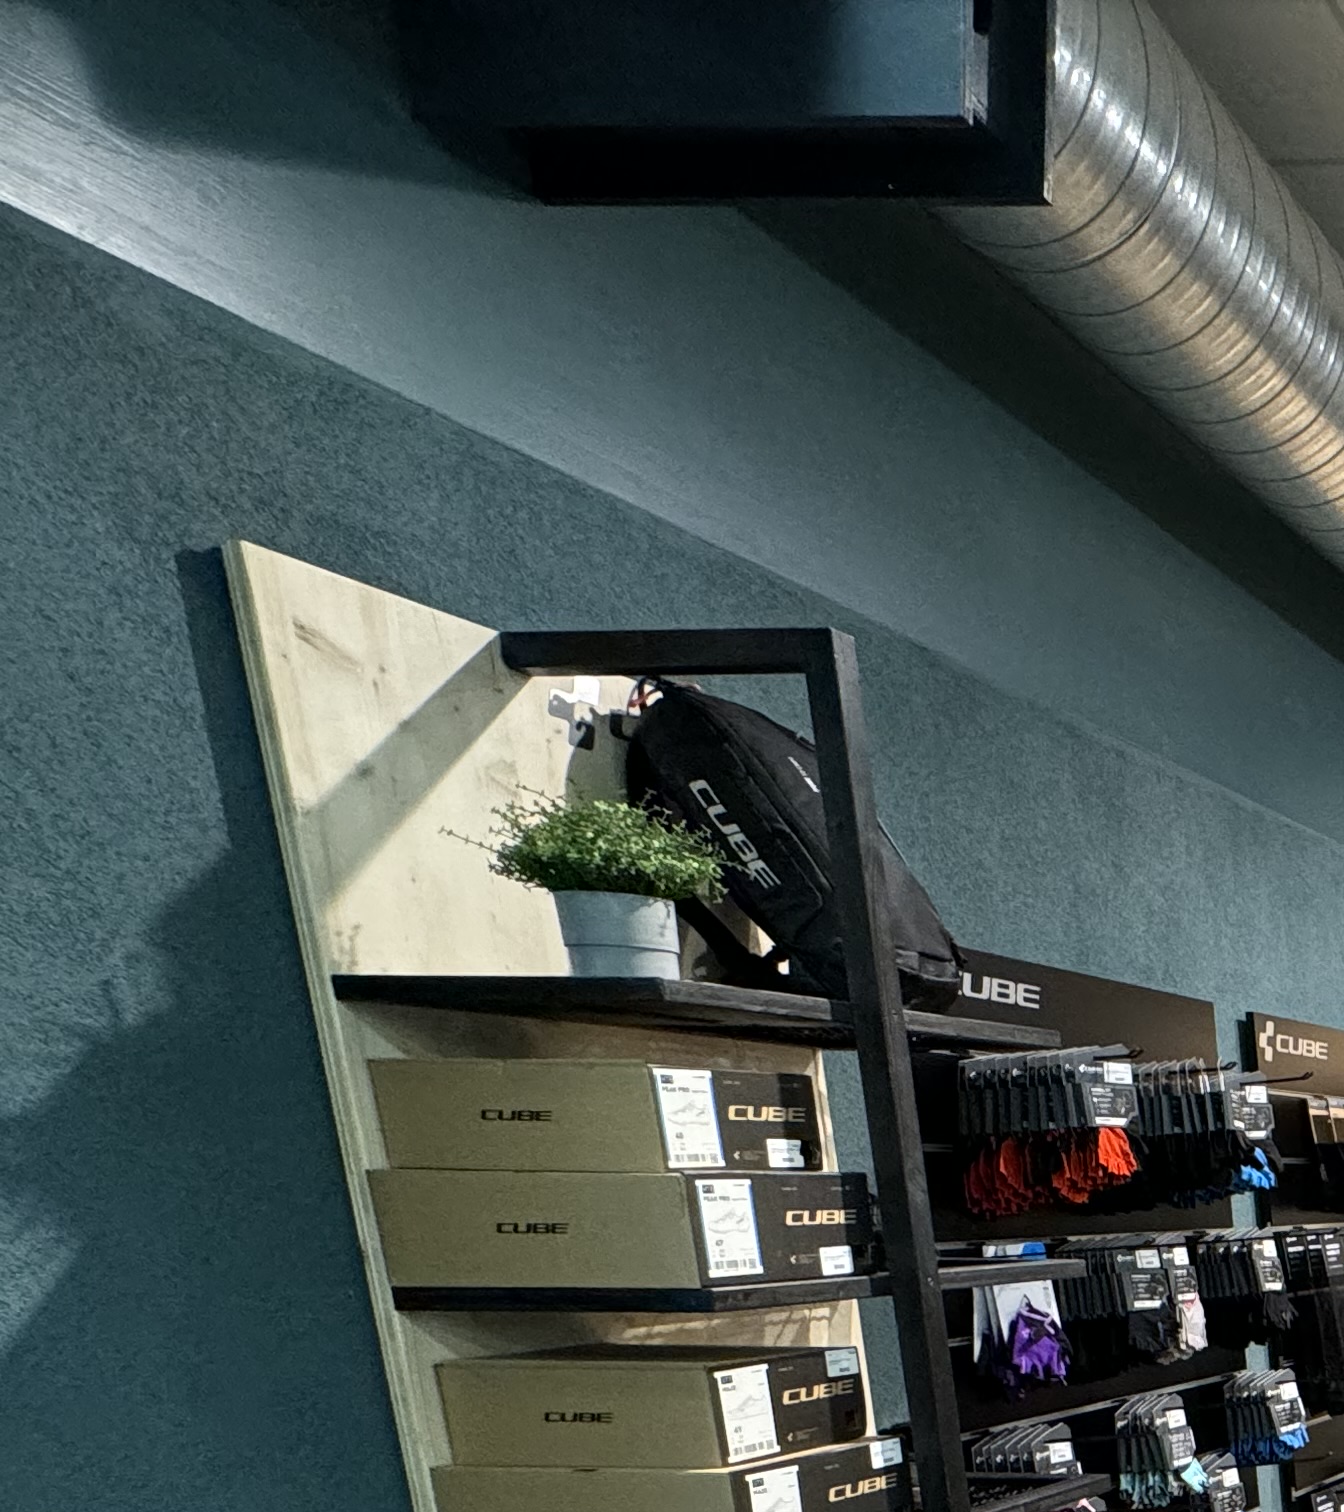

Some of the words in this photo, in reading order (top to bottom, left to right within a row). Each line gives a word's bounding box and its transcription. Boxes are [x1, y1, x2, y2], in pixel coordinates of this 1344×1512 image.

[689, 779, 782, 889] CUBE
[957, 970, 1042, 1010] UBE
[1275, 1033, 1329, 1061] CUBE
[481, 1109, 553, 1122] CUBE
[728, 1105, 807, 1123] CUBE
[496, 1222, 569, 1235] CUBE
[785, 1209, 858, 1227] CUBE
[782, 1378, 855, 1406] CUBE
[544, 1411, 614, 1424] CUBE
[828, 1472, 898, 1503] CUBE
